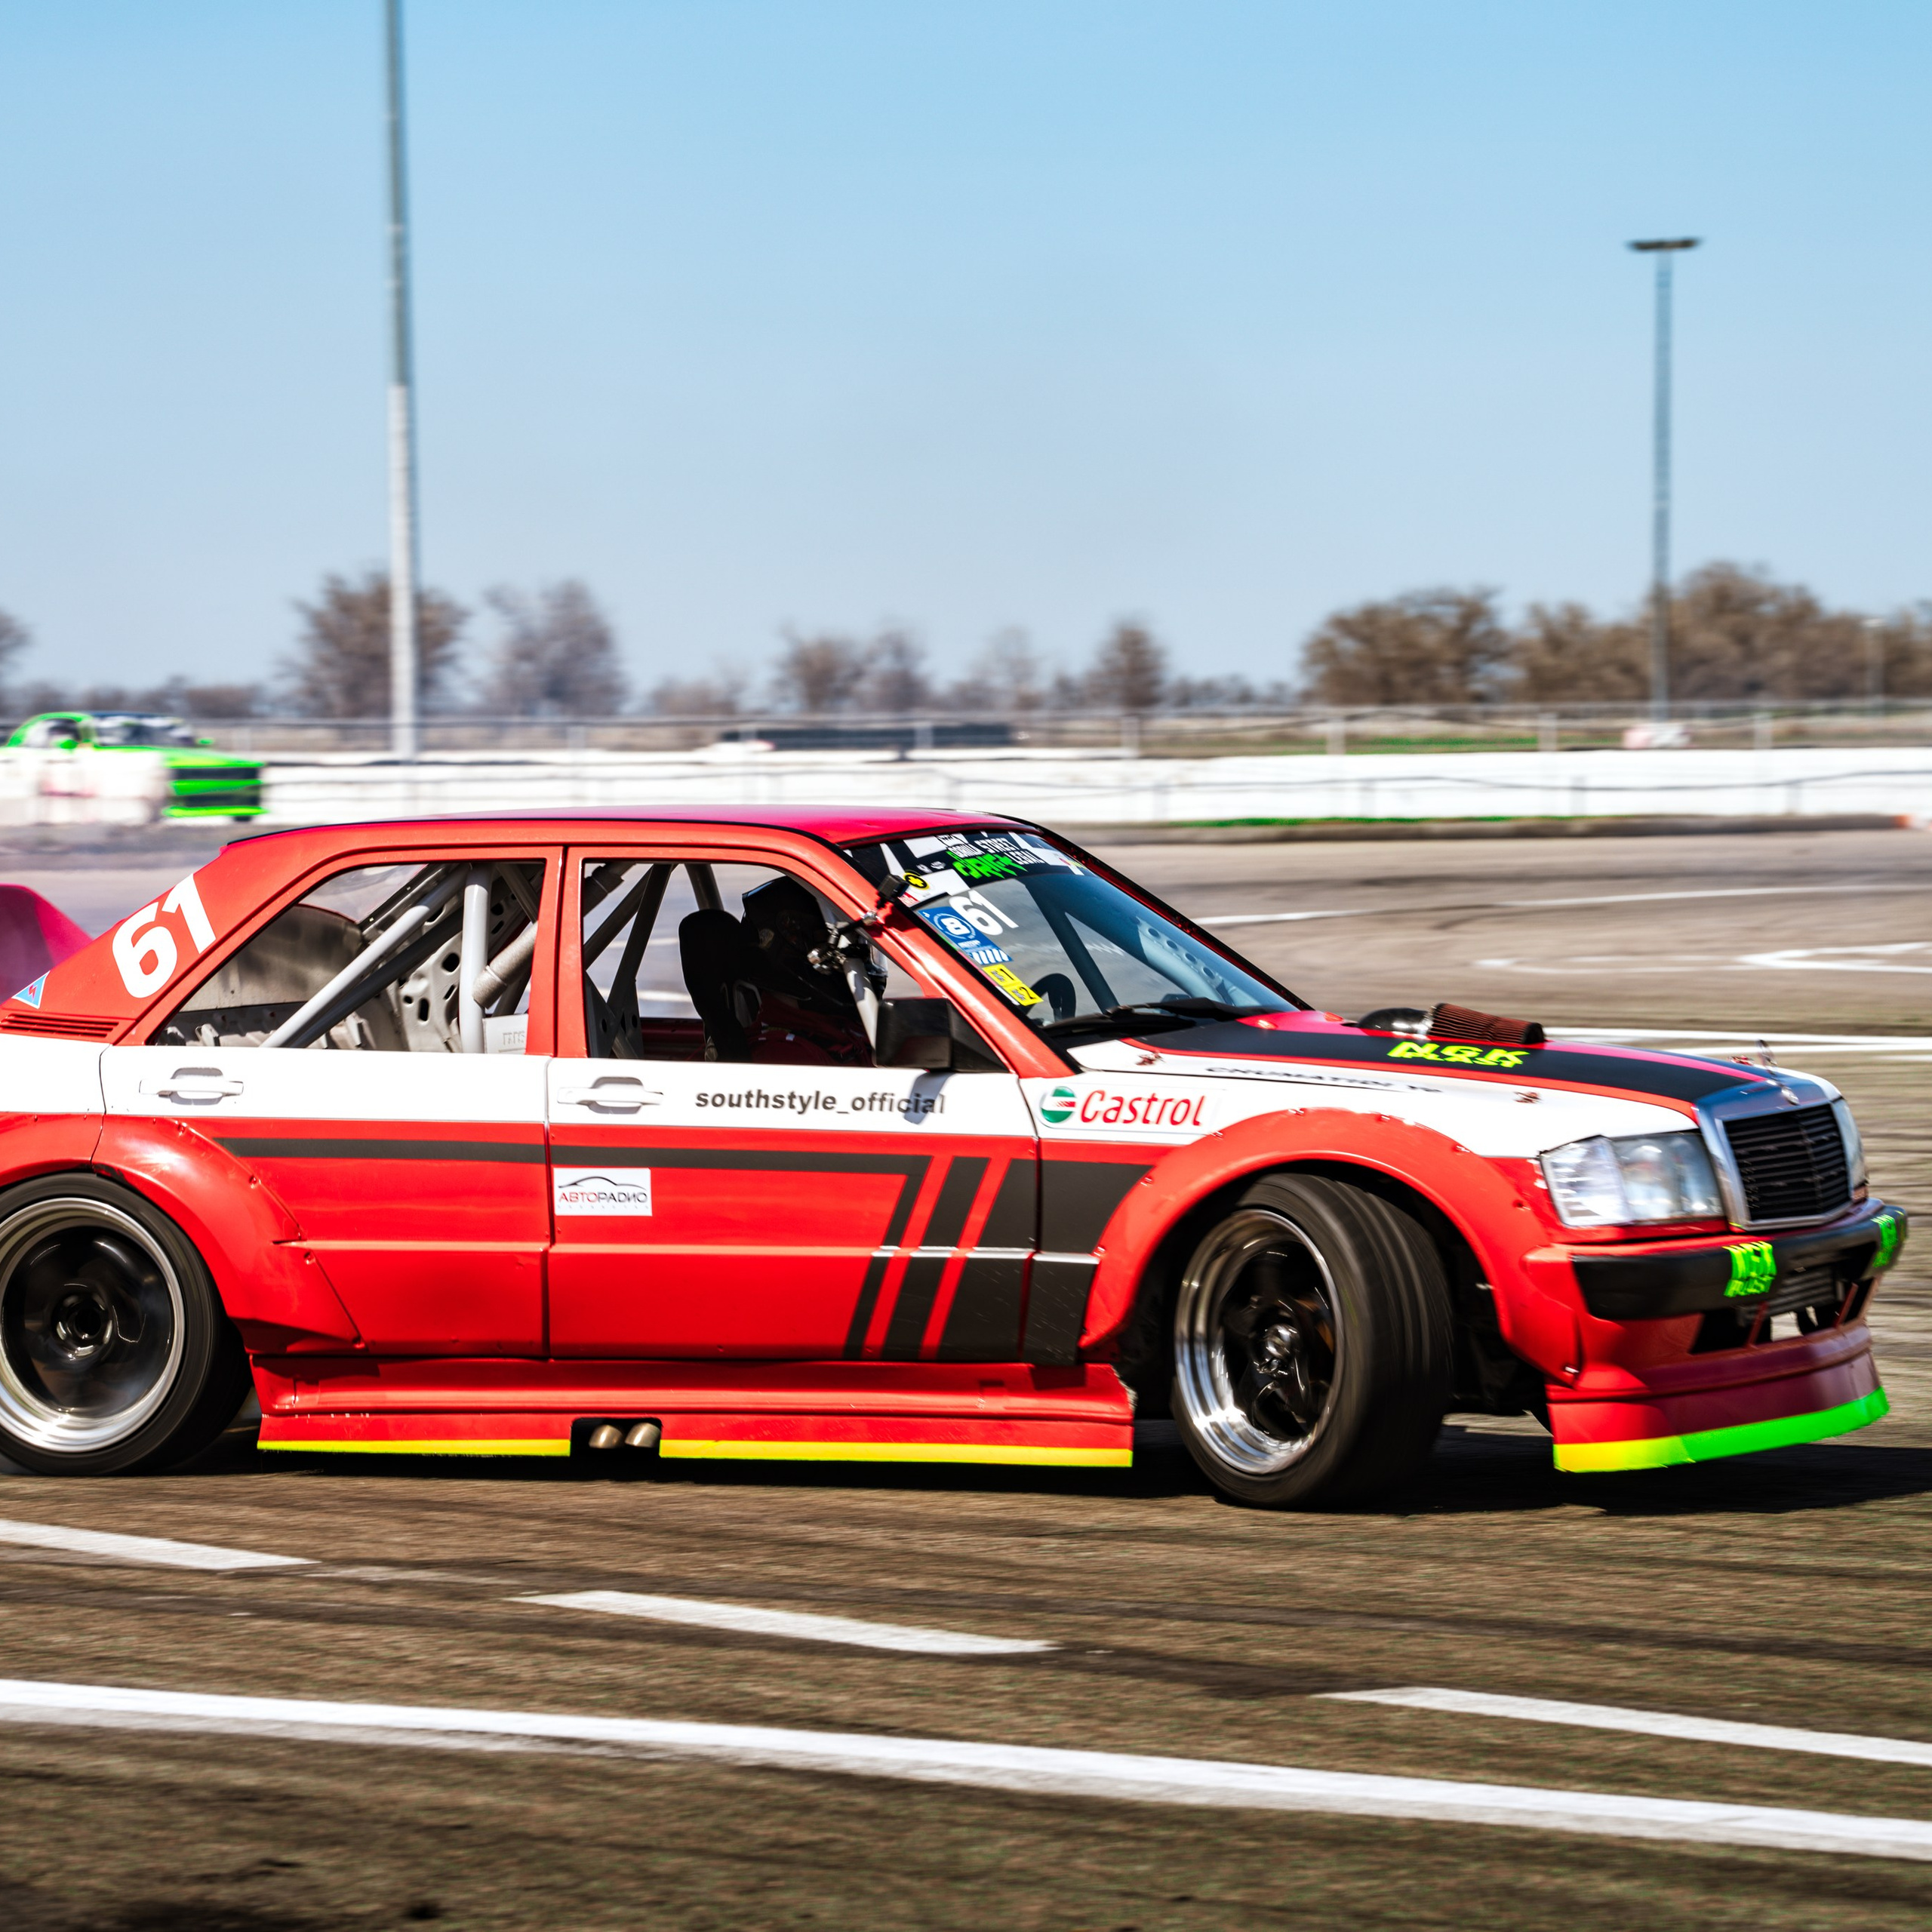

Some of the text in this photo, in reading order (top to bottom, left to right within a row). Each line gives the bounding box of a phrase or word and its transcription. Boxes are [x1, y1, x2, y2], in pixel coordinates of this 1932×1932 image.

[974, 837, 1021, 854] STREET
[1004, 849, 1046, 865] LEGAL
[949, 890, 1020, 936] 61
[112, 873, 217, 998] 61
[695, 1089, 946, 1115] southstyle_official
[1080, 1090, 1205, 1126] Castrol
